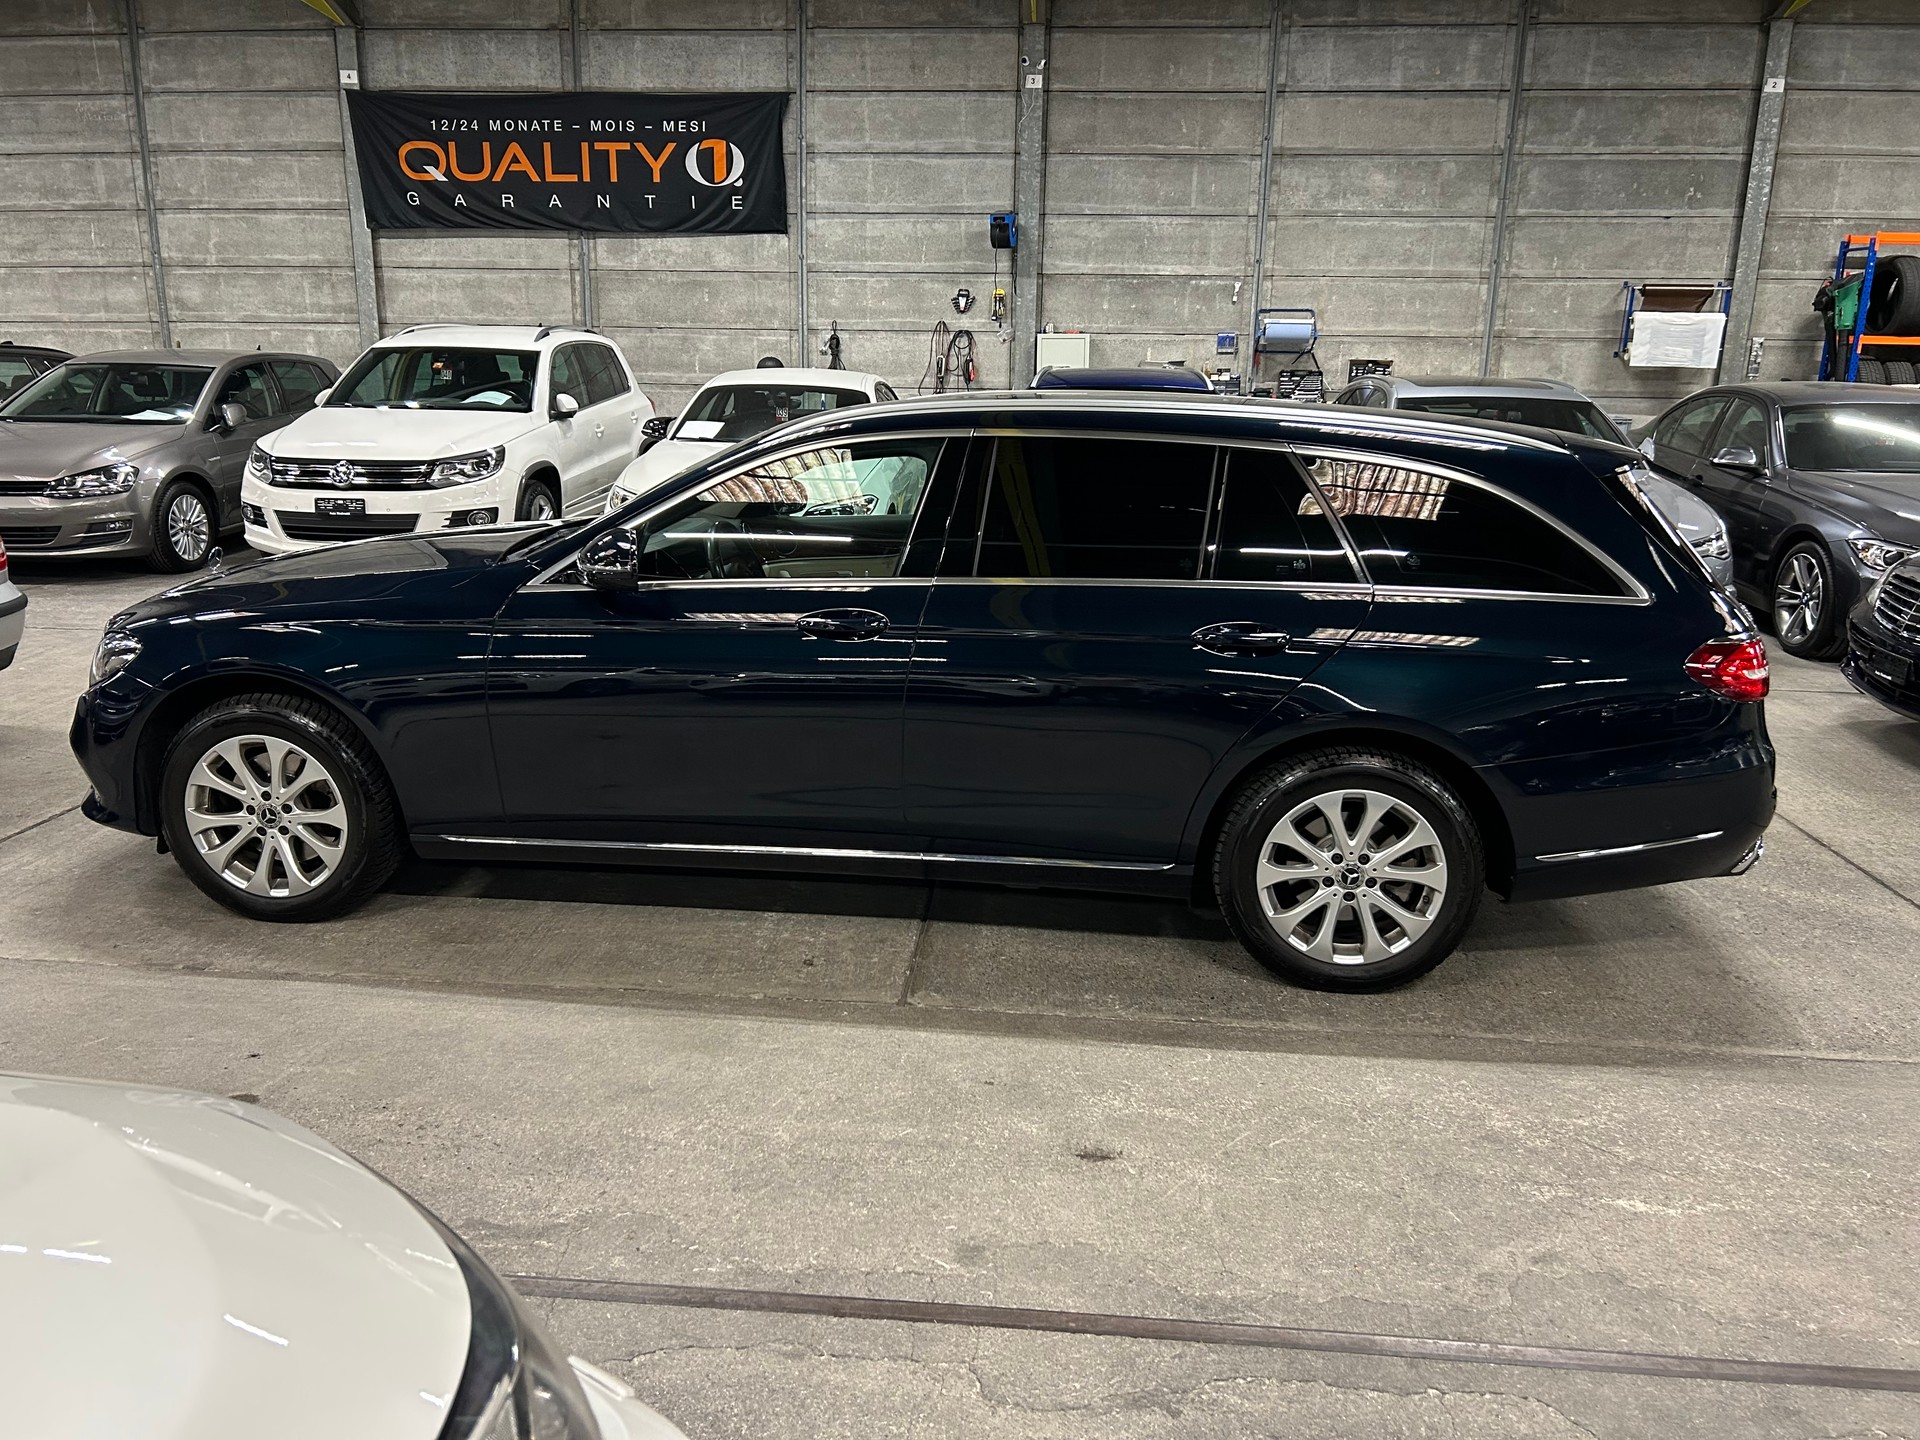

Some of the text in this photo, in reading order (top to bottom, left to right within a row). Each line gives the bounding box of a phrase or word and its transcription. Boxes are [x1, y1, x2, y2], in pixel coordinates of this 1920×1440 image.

[430, 119, 479, 131] 12/24
[489, 119, 563, 132] MONATE
[590, 120, 636, 132] MOIS
[662, 120, 706, 132] MESI
[398, 140, 678, 182] QUALITY
[406, 191, 743, 210] GARANTIE
